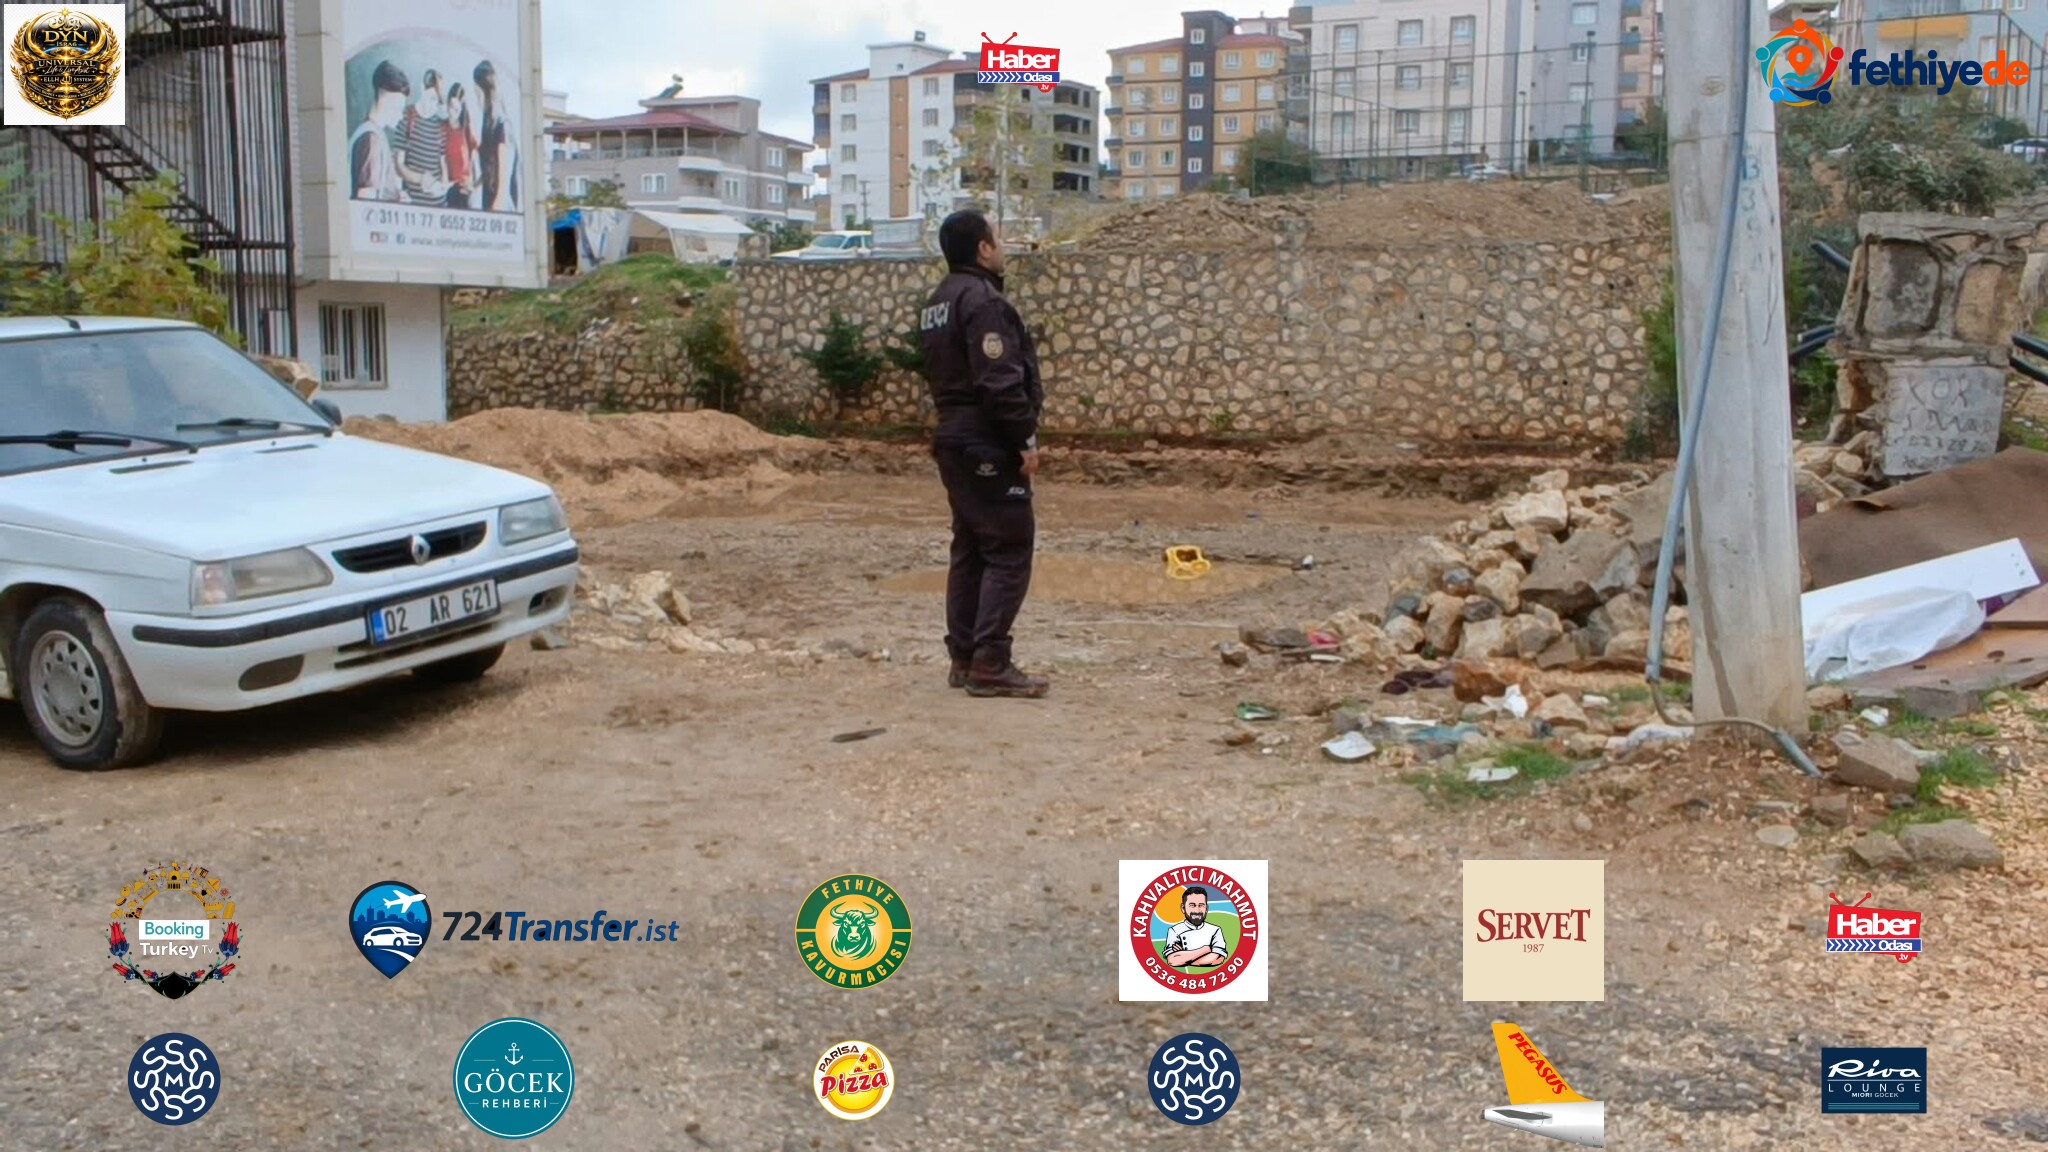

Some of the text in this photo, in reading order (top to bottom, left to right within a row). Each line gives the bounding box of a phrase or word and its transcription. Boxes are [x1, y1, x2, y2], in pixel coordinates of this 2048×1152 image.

[379, 209, 399, 224] 311
[404, 212, 416, 226] 11
[421, 213, 433, 228] 77
[384, 583, 492, 635] 02 AR 621
